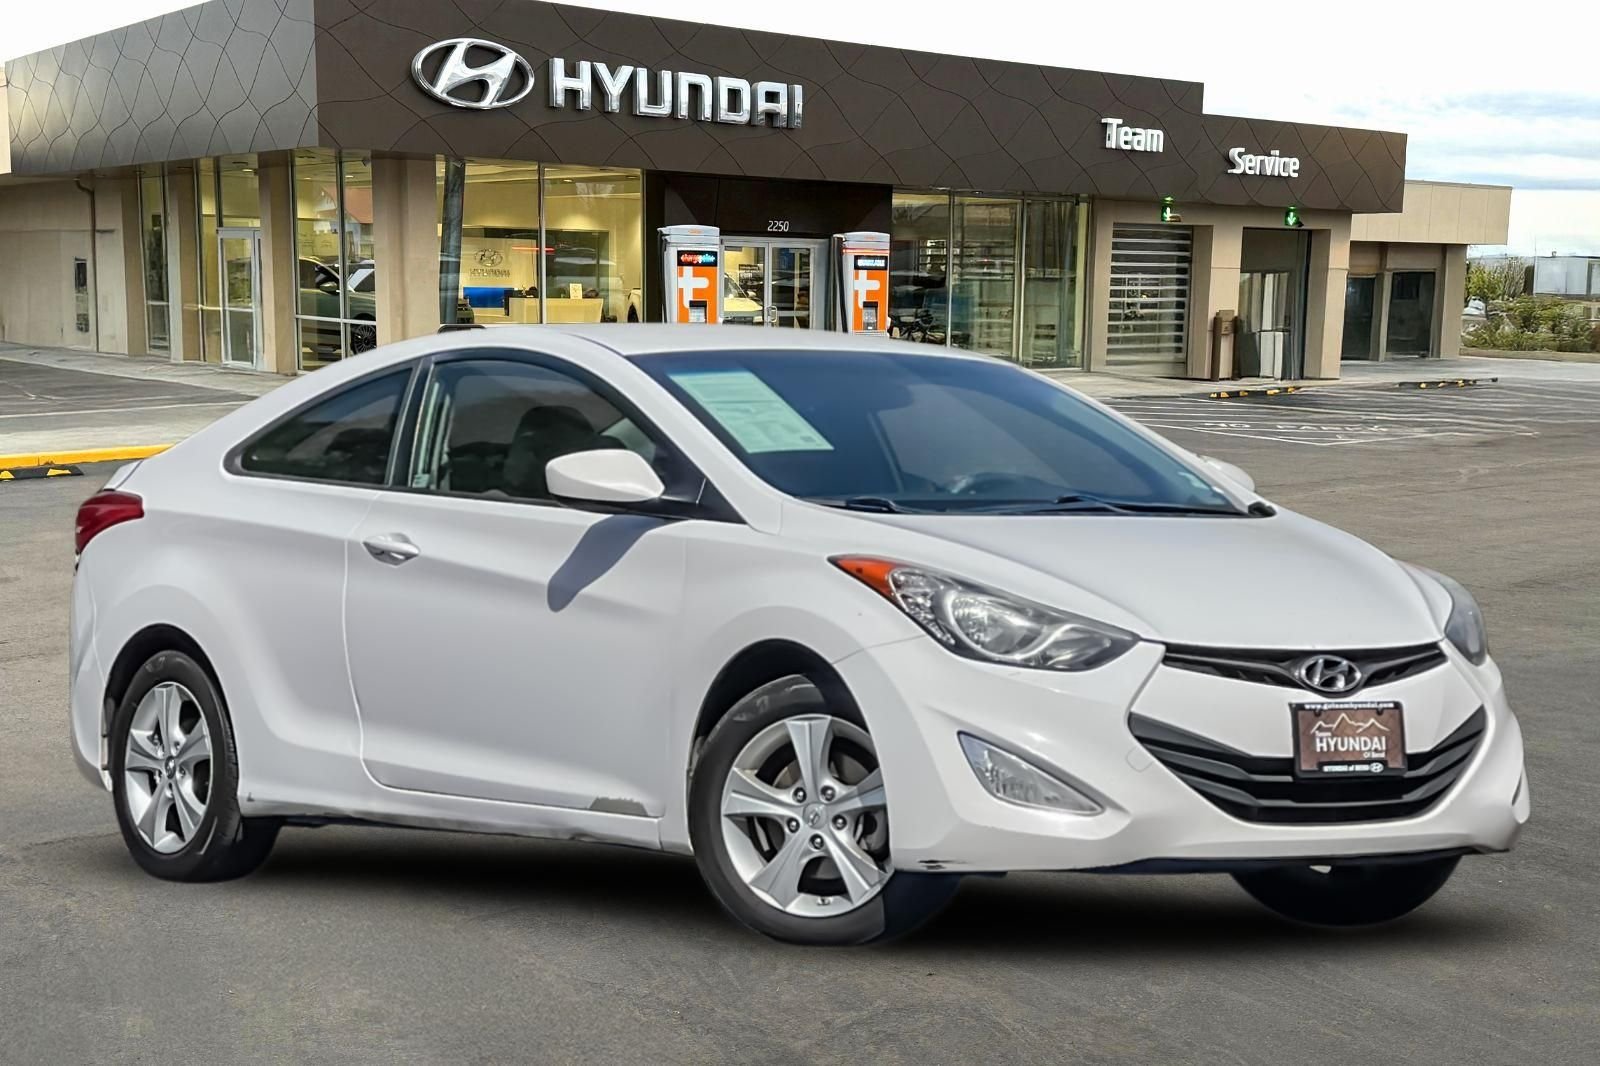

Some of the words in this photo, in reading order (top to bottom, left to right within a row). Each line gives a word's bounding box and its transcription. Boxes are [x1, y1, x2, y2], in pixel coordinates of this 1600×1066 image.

[549, 57, 803, 129] HYUNDAI
[1101, 117, 1164, 153] Team
[1227, 147, 1300, 178] Service
[767, 220, 790, 232] 2250
[1316, 736, 1386, 752] HYUNDAI
